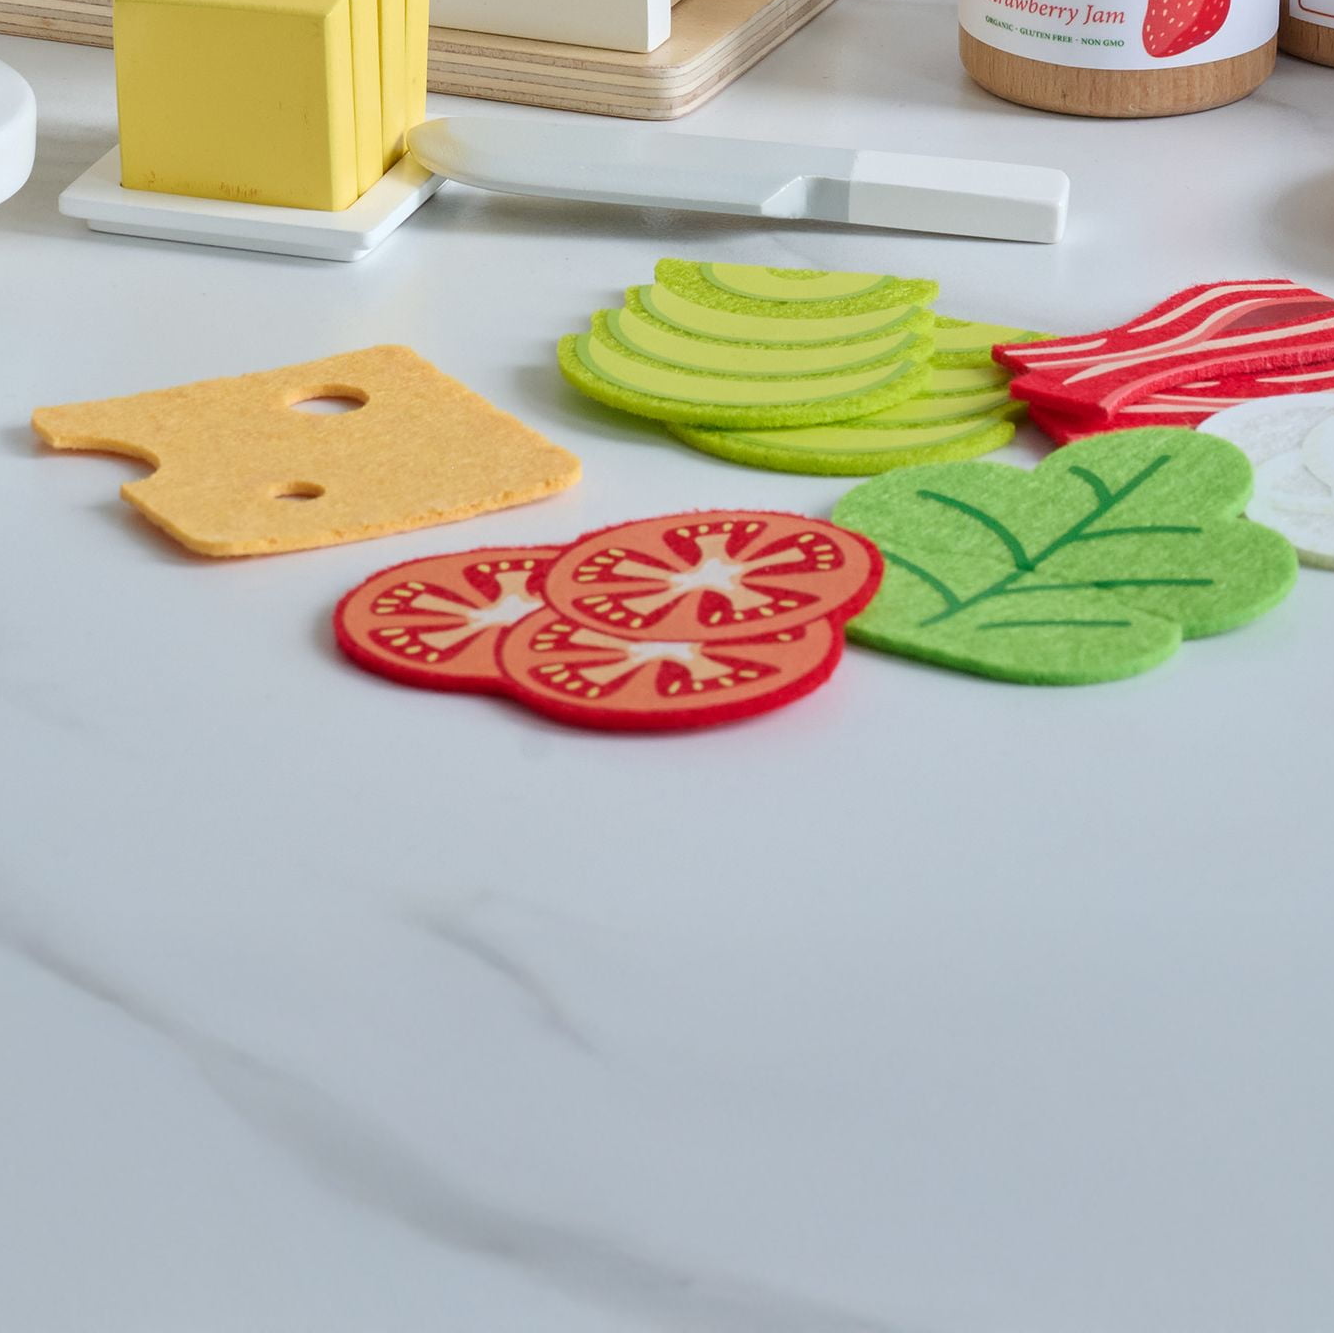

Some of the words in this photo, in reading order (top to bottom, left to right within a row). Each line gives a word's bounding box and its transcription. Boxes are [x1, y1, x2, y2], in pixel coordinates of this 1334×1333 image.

[1082, 4, 1126, 26] Jam
[984, 14, 1015, 32] ORGANIC
[1018, 26, 1051, 41] GLUTEN
[1052, 33, 1074, 44] FREE
[1080, 36, 1102, 46] NON
[1102, 39, 1126, 48] GMO
